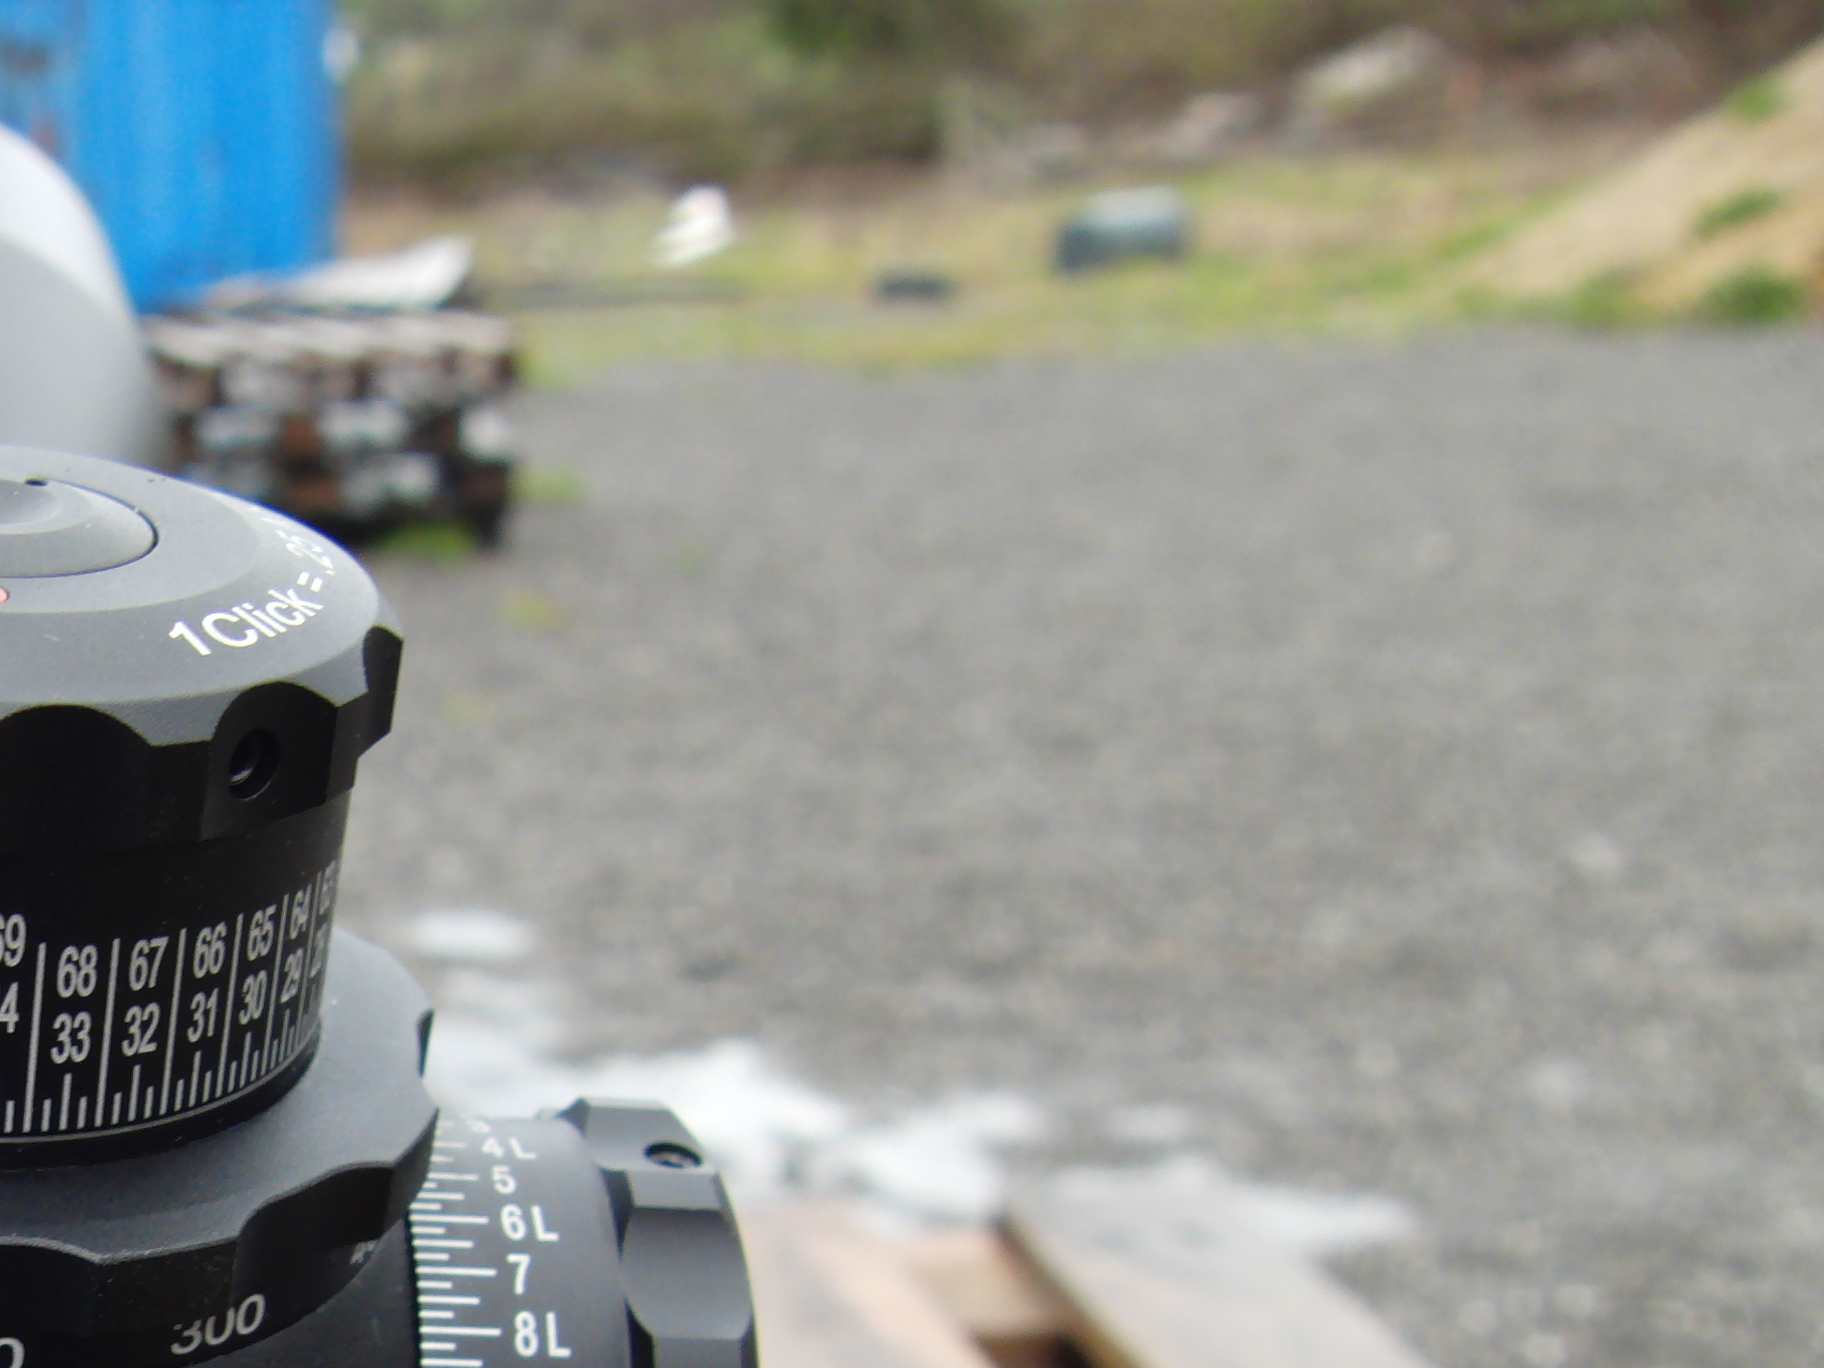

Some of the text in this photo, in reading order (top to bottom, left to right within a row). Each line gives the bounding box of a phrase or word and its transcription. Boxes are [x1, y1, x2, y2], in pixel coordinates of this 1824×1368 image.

[56, 945, 98, 998] 68
[128, 936, 169, 991] 67
[192, 922, 227, 979] 66
[246, 904, 277, 961] 65
[50, 1011, 92, 1064] 33
[122, 1003, 160, 1057] 32
[187, 988, 219, 1043] 31
[238, 970, 267, 1025] 30
[491, 1164, 517, 1195] 5
[507, 1253, 531, 1295] 7
